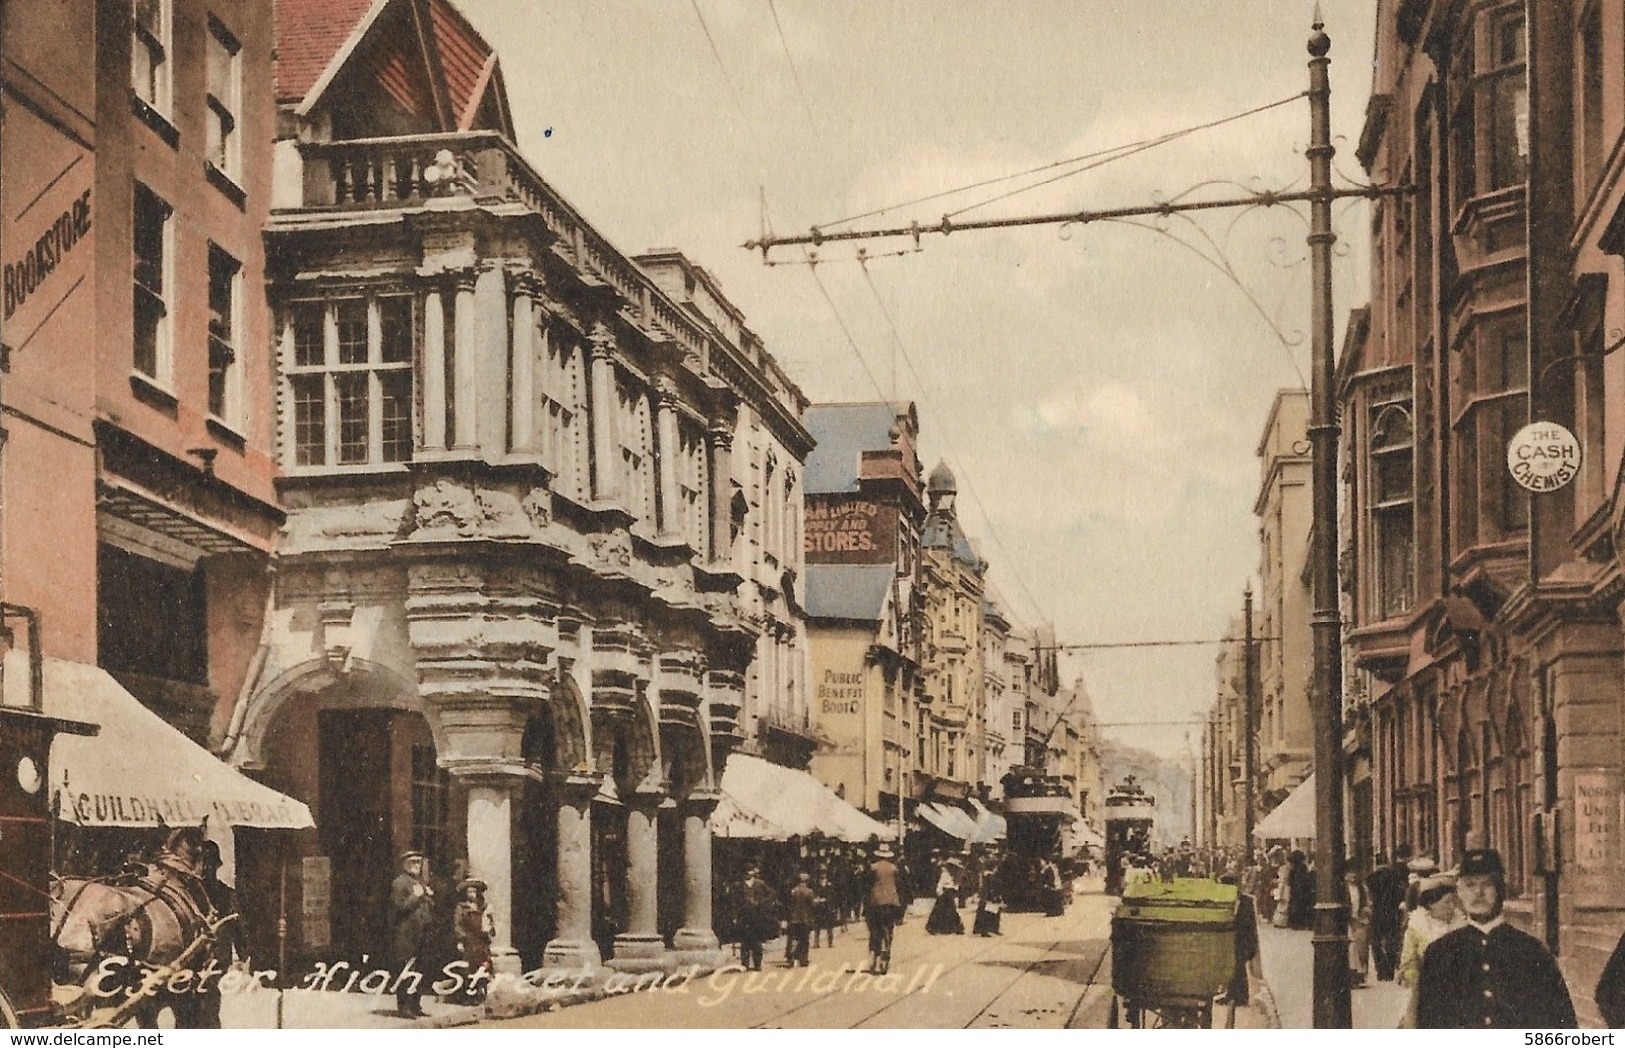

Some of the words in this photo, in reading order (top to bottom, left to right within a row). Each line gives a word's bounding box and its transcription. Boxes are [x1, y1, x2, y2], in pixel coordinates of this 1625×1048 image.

[4, 188, 91, 321] BOOKSTORE
[1531, 430, 1560, 440] THE
[1517, 444, 1573, 460] CASH
[1513, 461, 1576, 490] CHEMIST
[803, 531, 877, 552] STORES.
[824, 669, 862, 684] PUBLIC
[818, 684, 863, 698] BENEFIT
